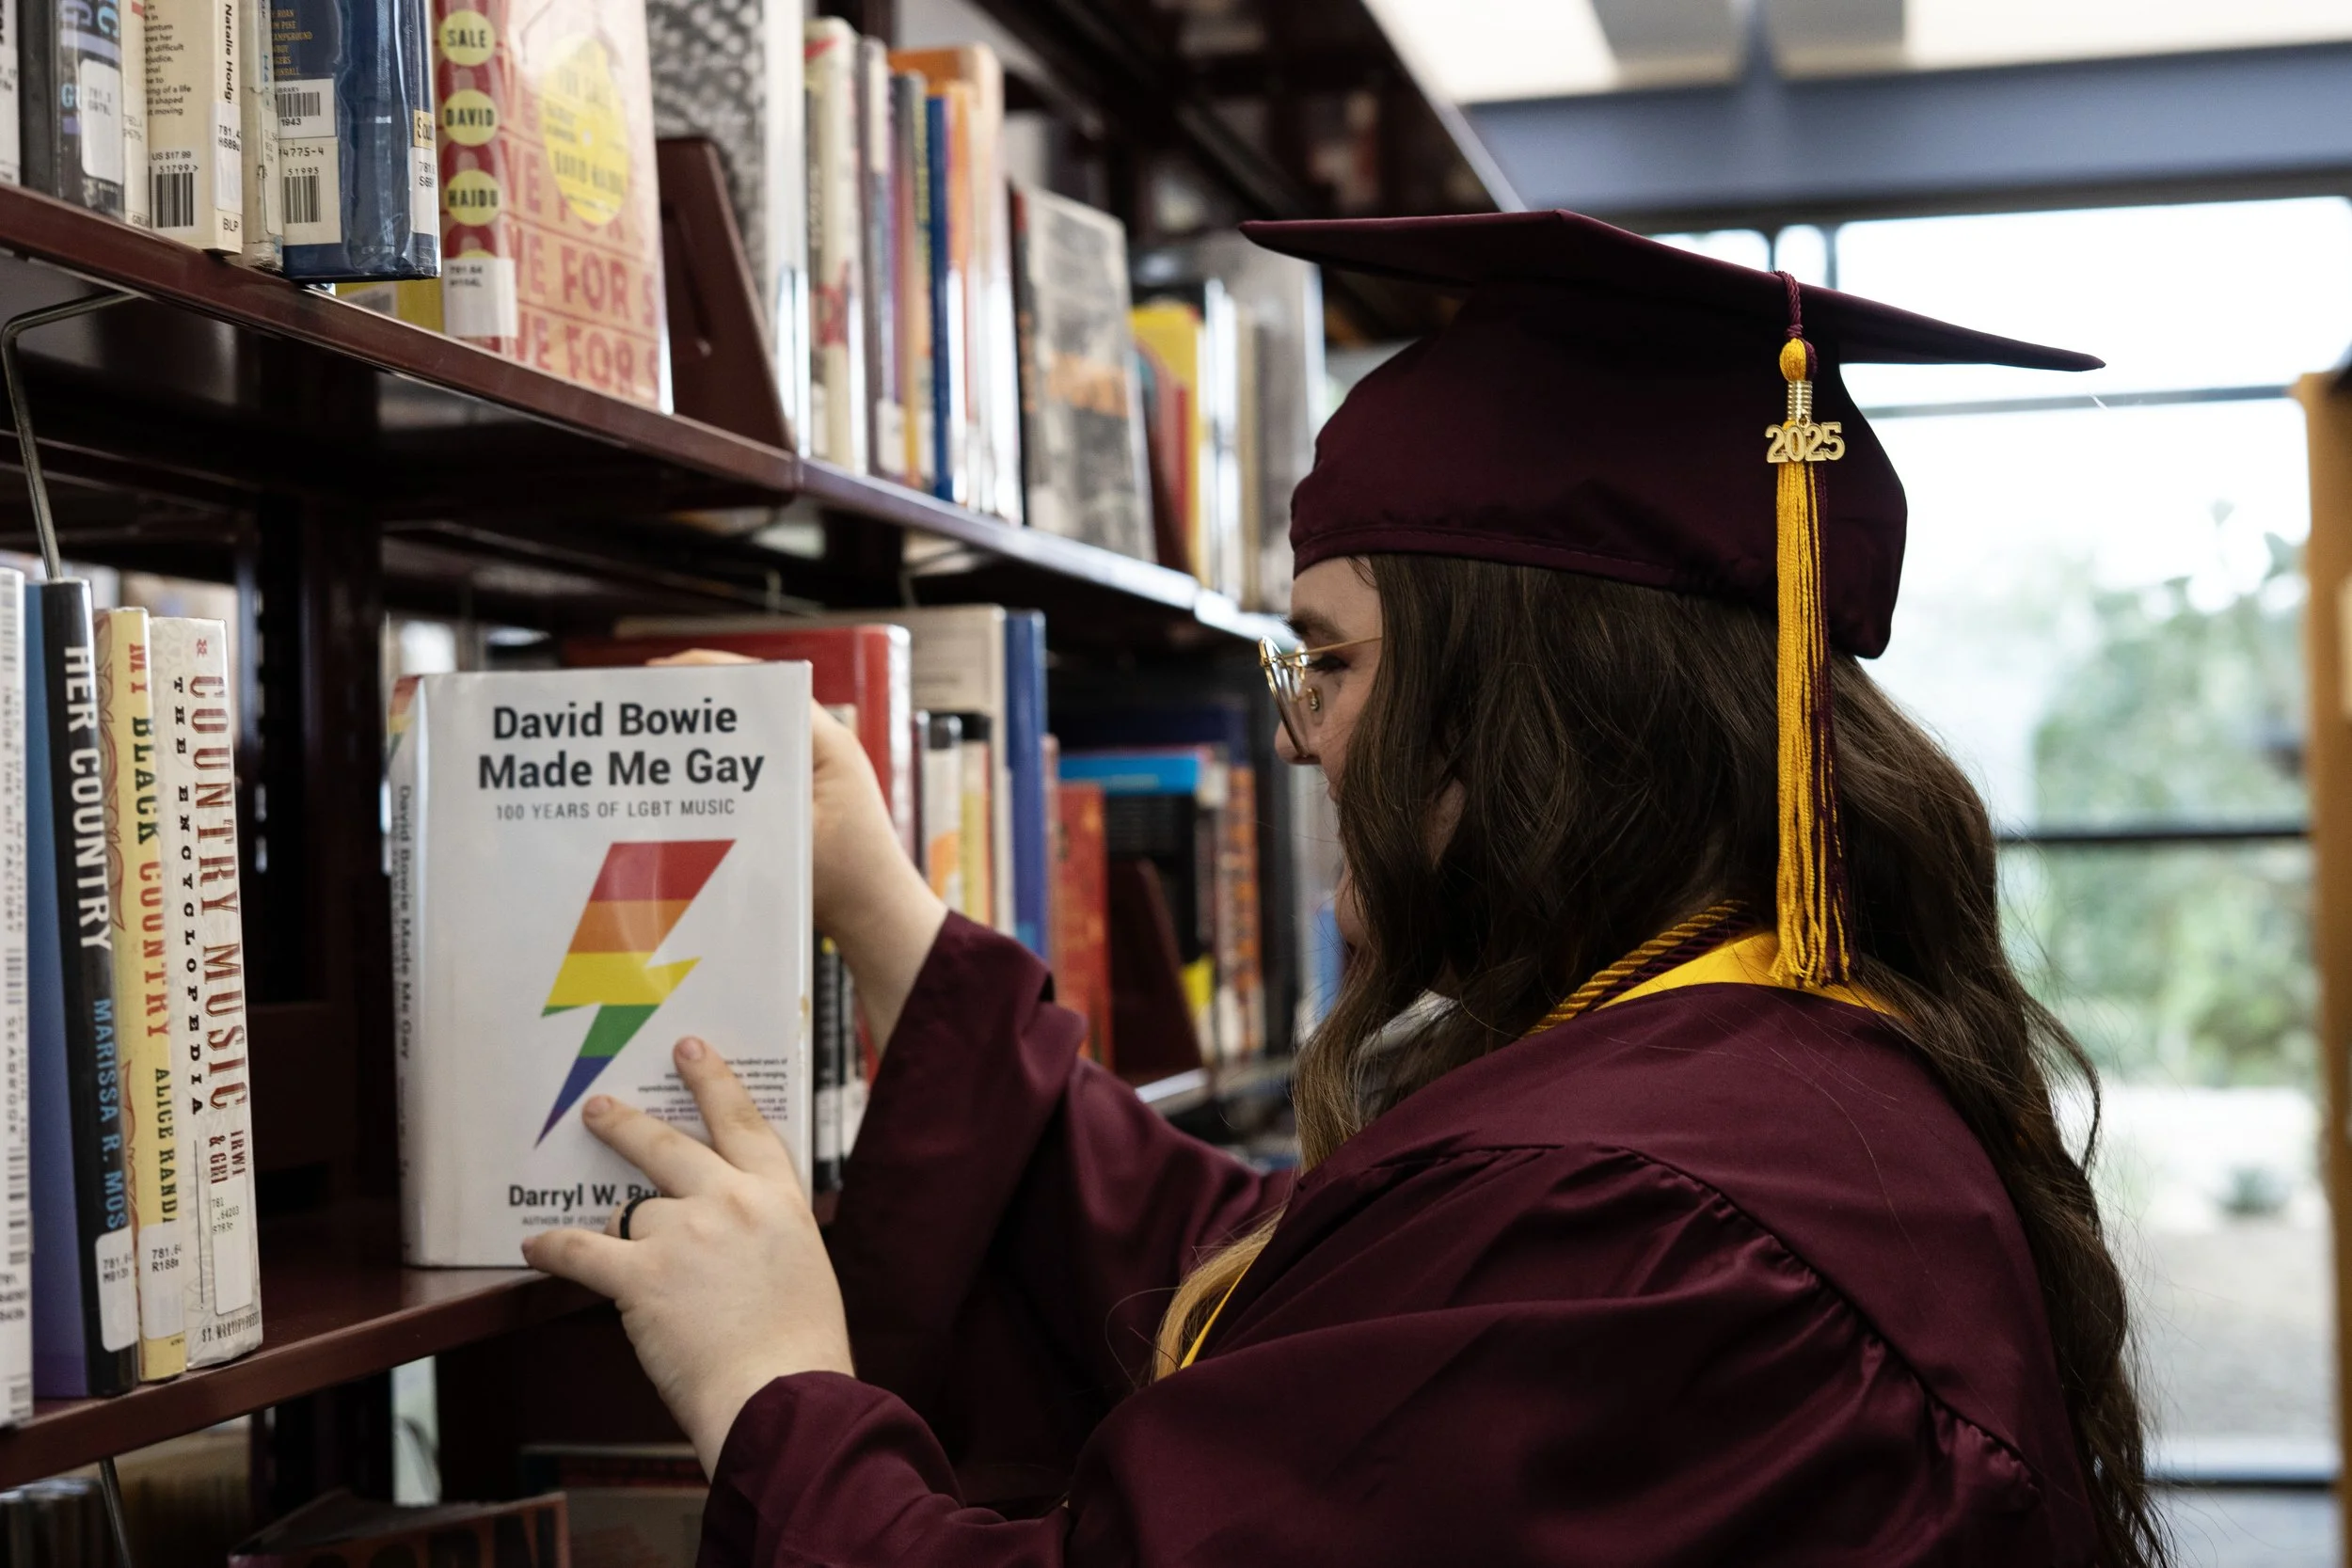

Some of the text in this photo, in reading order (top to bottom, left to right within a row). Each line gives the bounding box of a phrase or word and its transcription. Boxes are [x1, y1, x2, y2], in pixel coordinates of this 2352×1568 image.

[154, 43, 184, 53] difficult
[224, 4, 234, 104] Natalie Hodg
[446, 27, 488, 50] SALE
[155, 96, 183, 106] shaped
[179, 85, 192, 93] life
[154, 107, 183, 116] moving
[280, 118, 302, 127] 1943
[445, 108, 495, 127] DAVID
[151, 152, 164, 161] US
[288, 166, 319, 176] 51995
[448, 188, 499, 209] HAJDU
[223, 217, 239, 232] BLP
[562, 242, 630, 322] FOR
[565, 325, 635, 395] FOR
[1765, 421, 1845, 463] 2025
[494, 698, 738, 740] David Bowie
[479, 748, 765, 792] Made Me Gay
[64, 646, 112, 951] HER COUNTRY
[400, 785, 412, 842] David
[496, 799, 735, 820] 100 YEARS OF LGBT MUSIC
[129, 643, 170, 1037] MY BLACK COUNTRY
[174, 676, 203, 1115] THE ENCYCLOPEDIA
[190, 675, 248, 1111] COUNTRY MUSIC
[400, 848, 412, 911] Bowie
[401, 918, 412, 975] Made
[402, 982, 412, 1014] Me
[401, 1020, 413, 1060] Gay
[94, 998, 128, 1229] MARISSA R. MOS
[155, 1068, 178, 1224] ALICE RAND
[209, 1135, 226, 1148] &
[509, 1183, 583, 1212] Darryl
[592, 1184, 621, 1207] W.
[522, 1215, 560, 1226] AUTHOR
[202, 1325, 215, 1343] ST.
